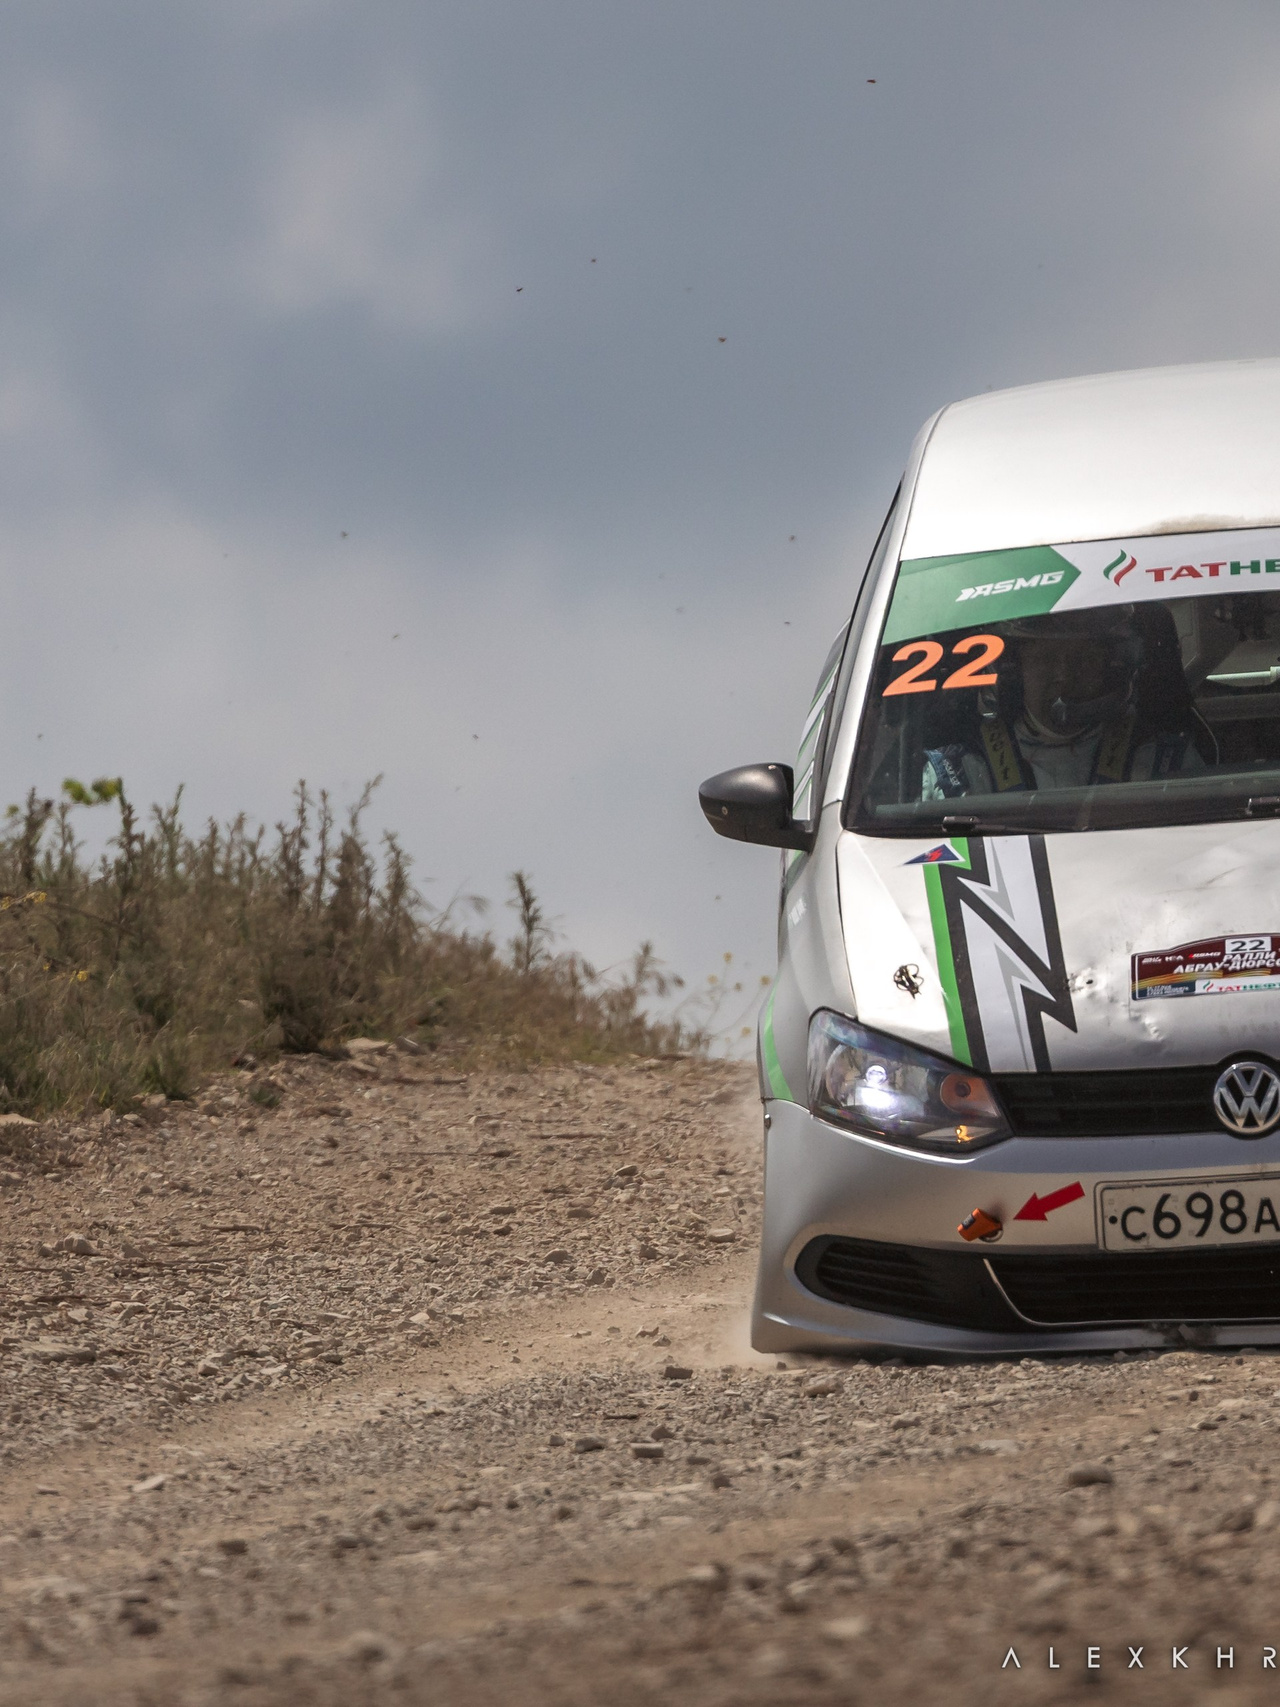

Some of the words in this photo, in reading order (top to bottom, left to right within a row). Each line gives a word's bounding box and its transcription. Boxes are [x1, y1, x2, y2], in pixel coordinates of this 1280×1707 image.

[882, 634, 1005, 697] 22
[1230, 940, 1265, 953] 22
[1222, 951, 1276, 962] РАЛЛИ
